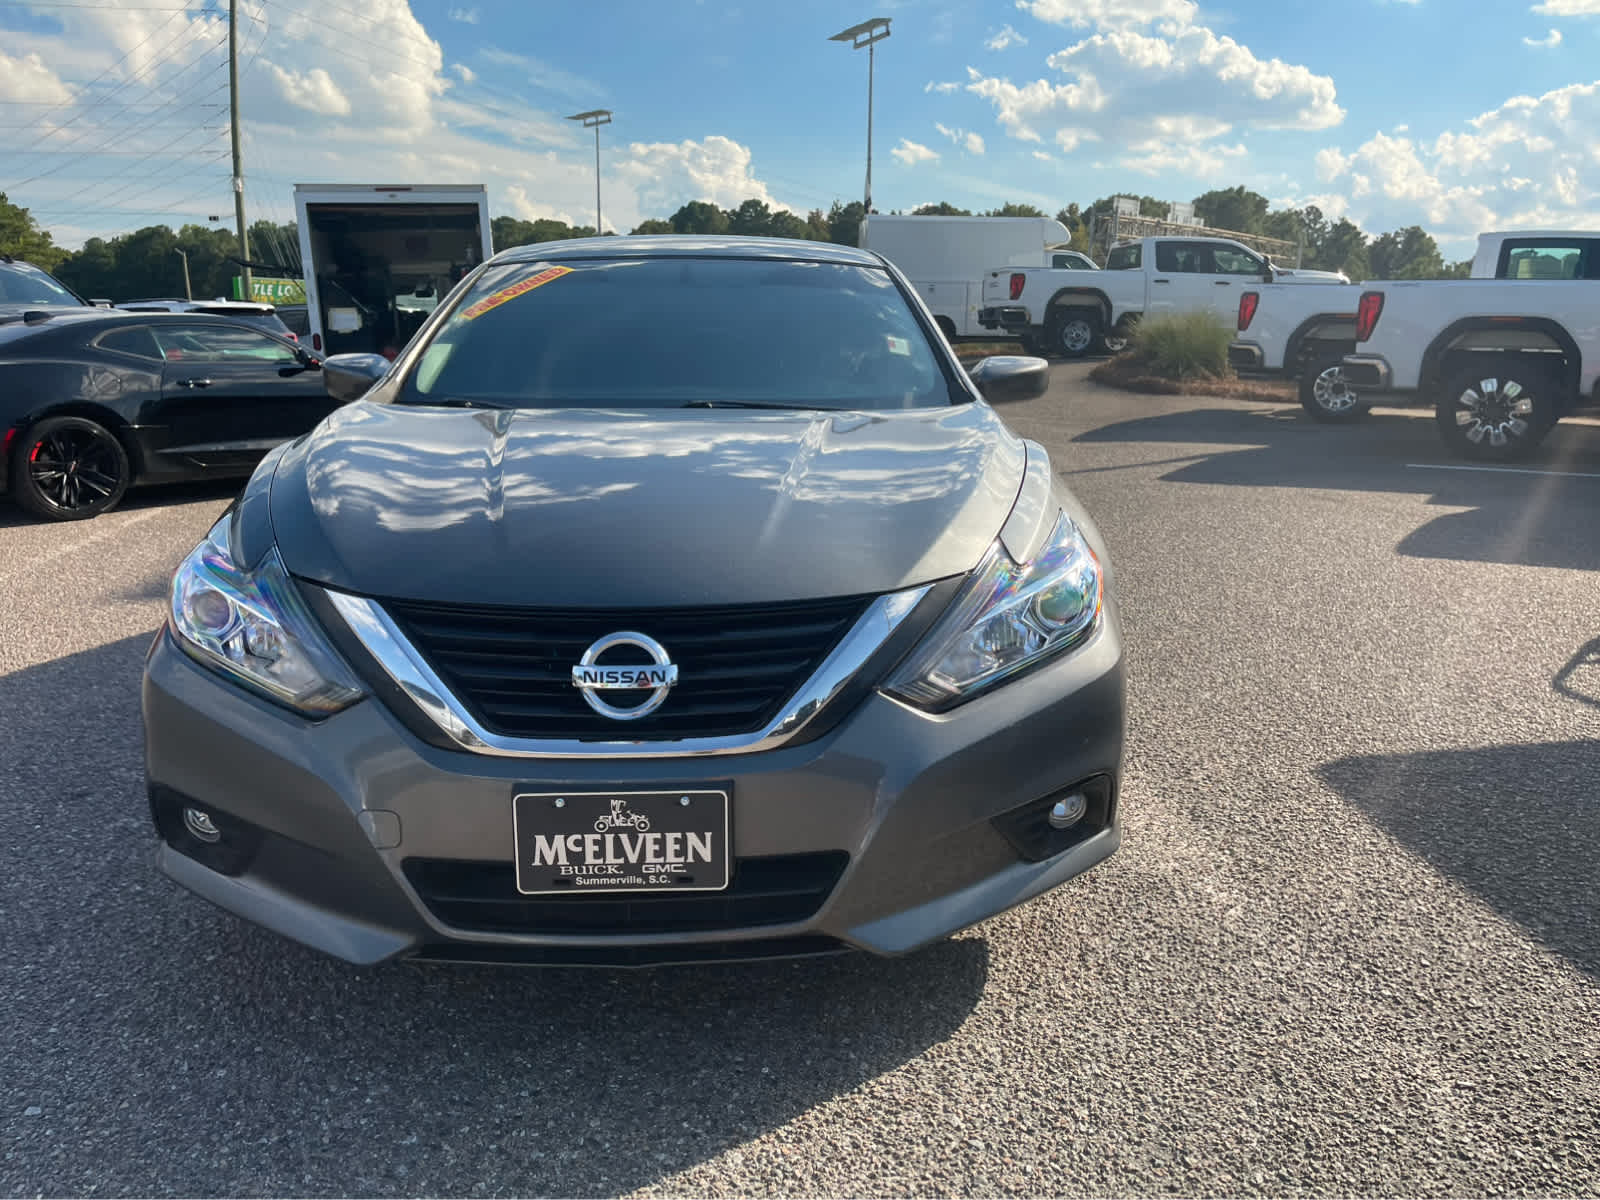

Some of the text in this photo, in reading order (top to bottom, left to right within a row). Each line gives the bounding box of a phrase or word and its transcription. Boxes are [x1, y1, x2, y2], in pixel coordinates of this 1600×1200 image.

[583, 670, 667, 684] NISSAN
[531, 831, 713, 867] McELVEEN
[575, 875, 671, 886] Summerville, S.C.
